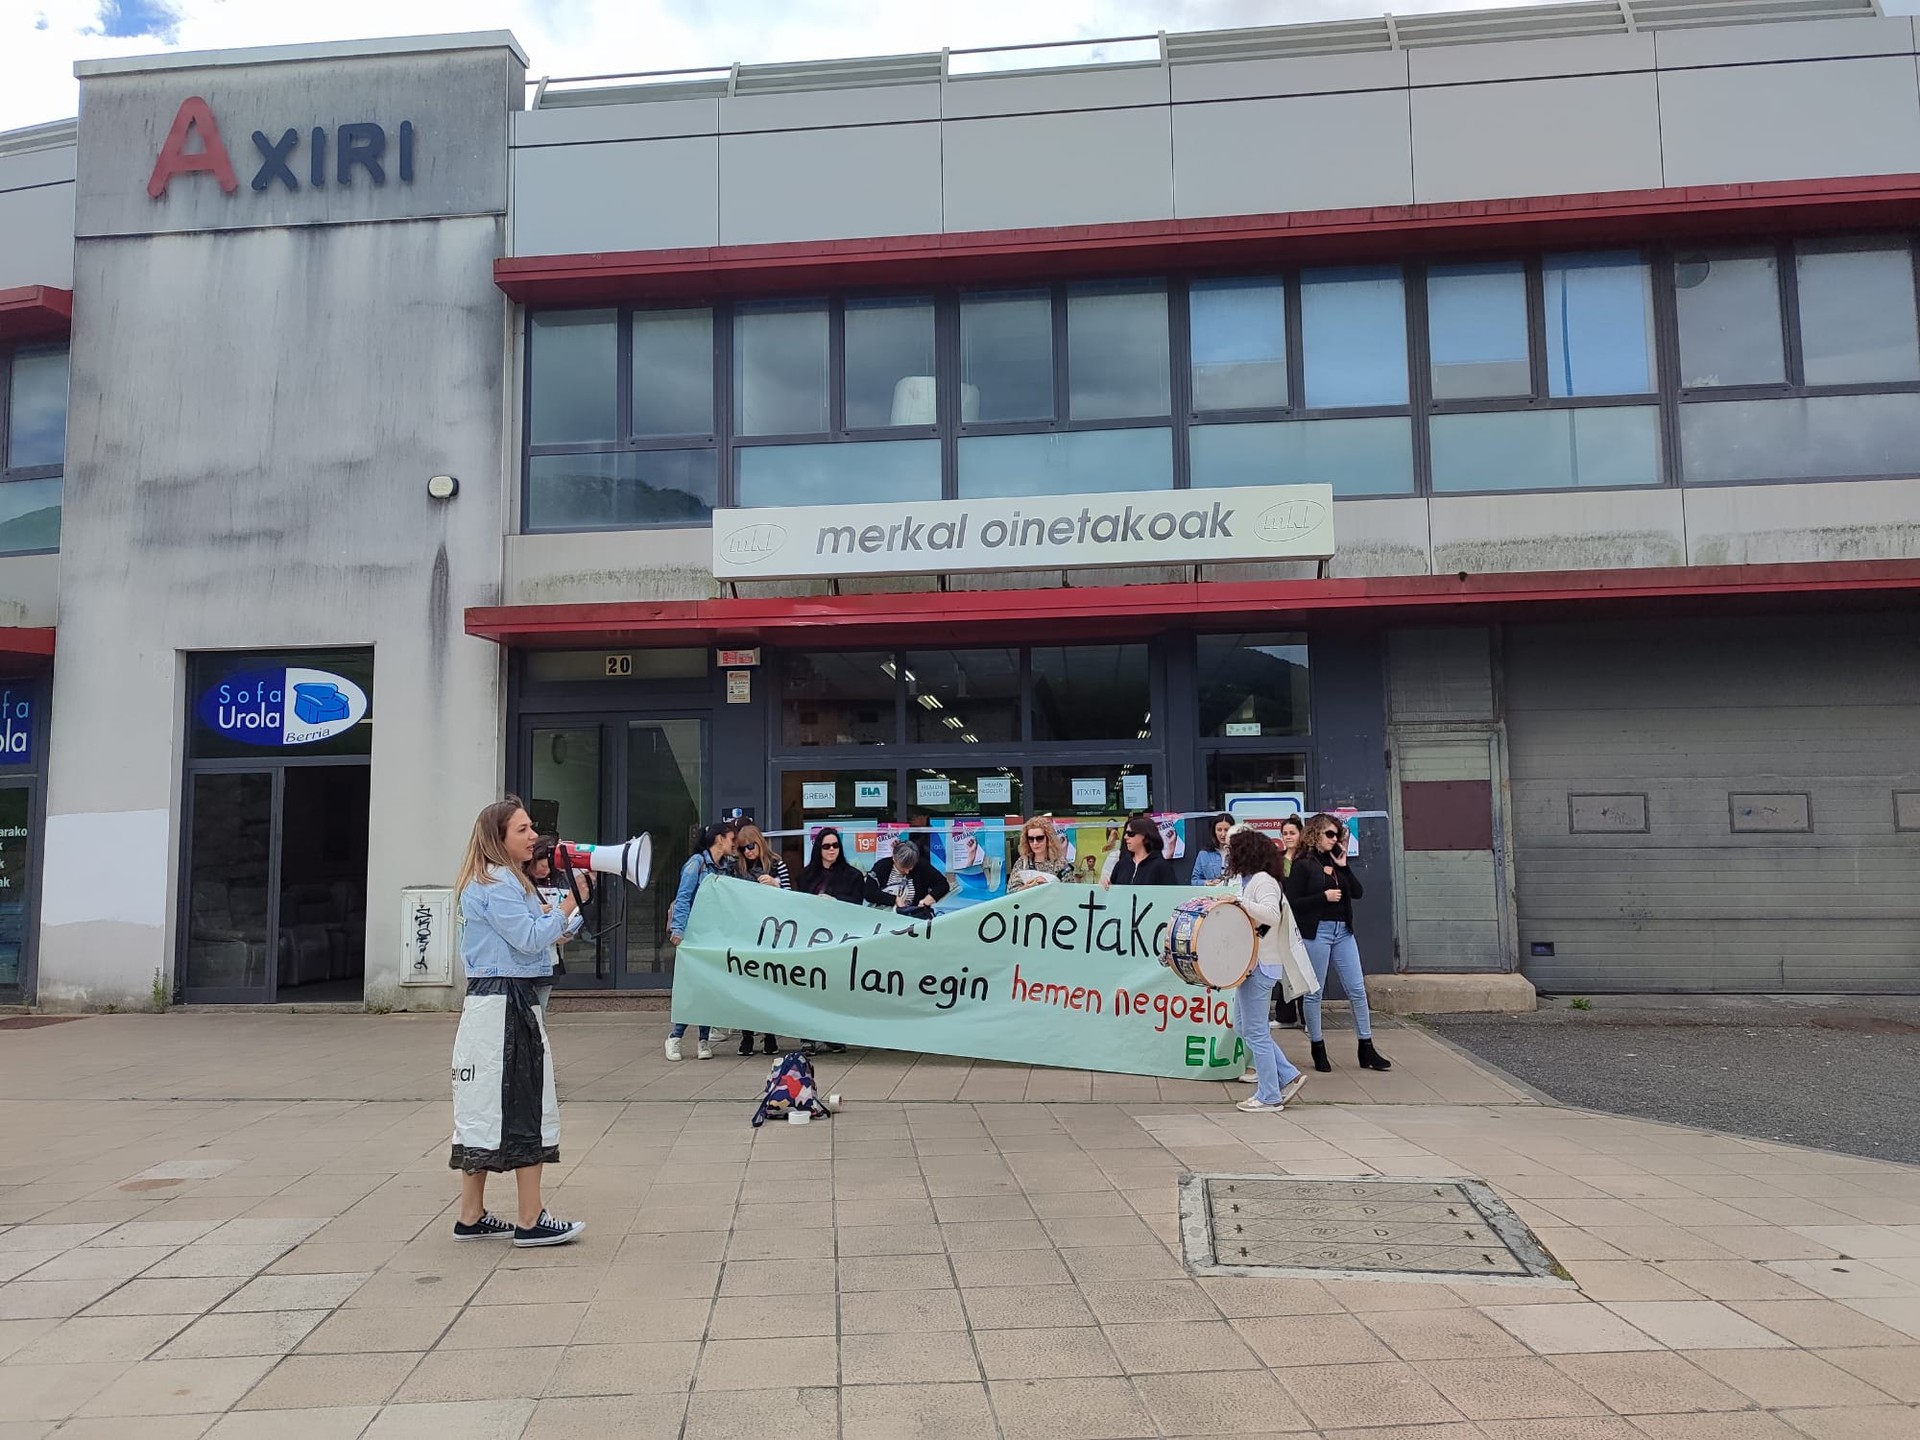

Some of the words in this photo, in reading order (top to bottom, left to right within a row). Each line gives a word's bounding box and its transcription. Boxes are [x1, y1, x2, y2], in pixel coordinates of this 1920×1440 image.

[147, 96, 413, 198] AXIRI
[816, 513, 968, 555] merkal
[980, 502, 1235, 548] oinetakoak
[608, 657, 630, 673] 20
[219, 682, 281, 704] Sofa
[219, 702, 280, 729] Urola
[286, 727, 330, 743] Berria
[804, 792, 835, 800] GREBAN
[861, 787, 880, 795] ELA
[1076, 788, 1101, 796] ITXITA
[858, 838, 869, 850] 19
[727, 948, 826, 990] hemen
[849, 946, 904, 996] lan
[918, 967, 989, 1009] egin
[1012, 964, 1101, 1014] hemen
[1115, 988, 1234, 1032] negozia
[1185, 1035, 1245, 1068] ELA
